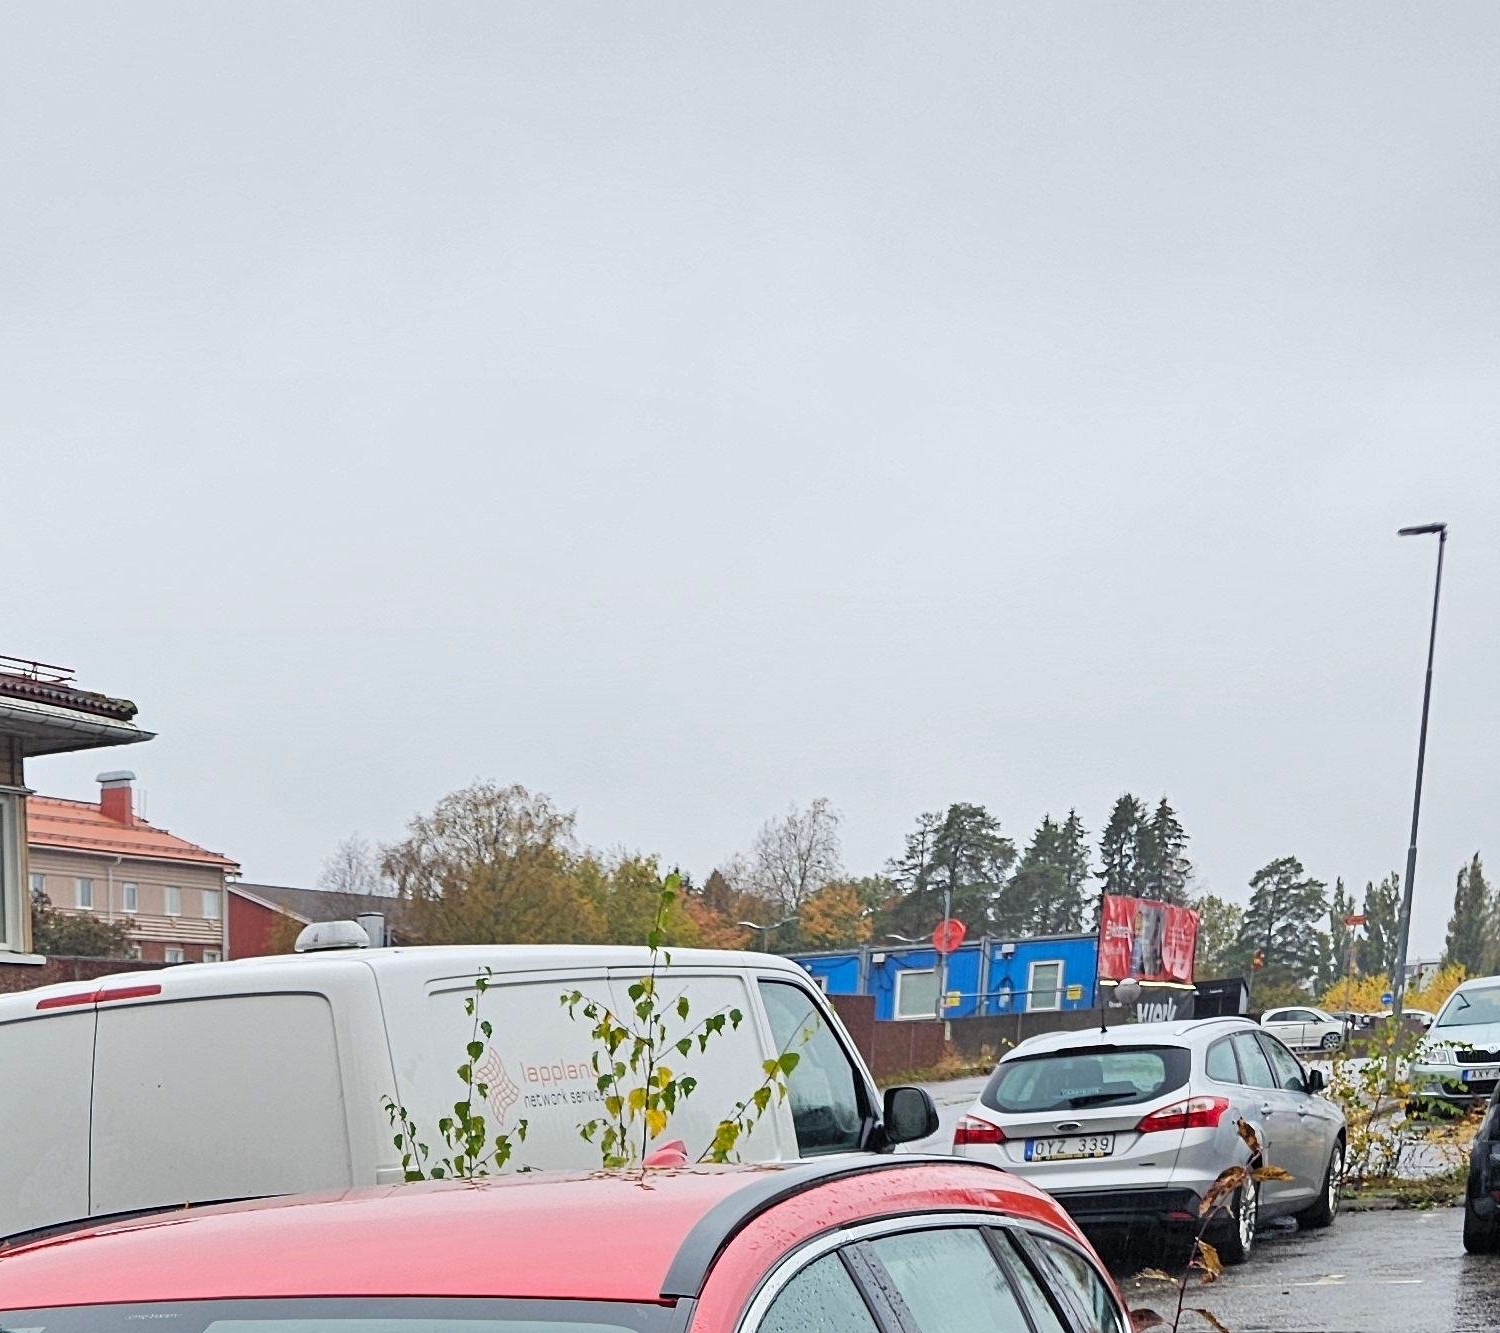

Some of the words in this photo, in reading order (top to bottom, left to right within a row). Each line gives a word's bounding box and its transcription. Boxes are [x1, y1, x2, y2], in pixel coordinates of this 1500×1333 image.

[523, 1089, 568, 1109] network
[1035, 1140, 1066, 1155] OYZ
[1078, 1137, 1109, 1151] 339
